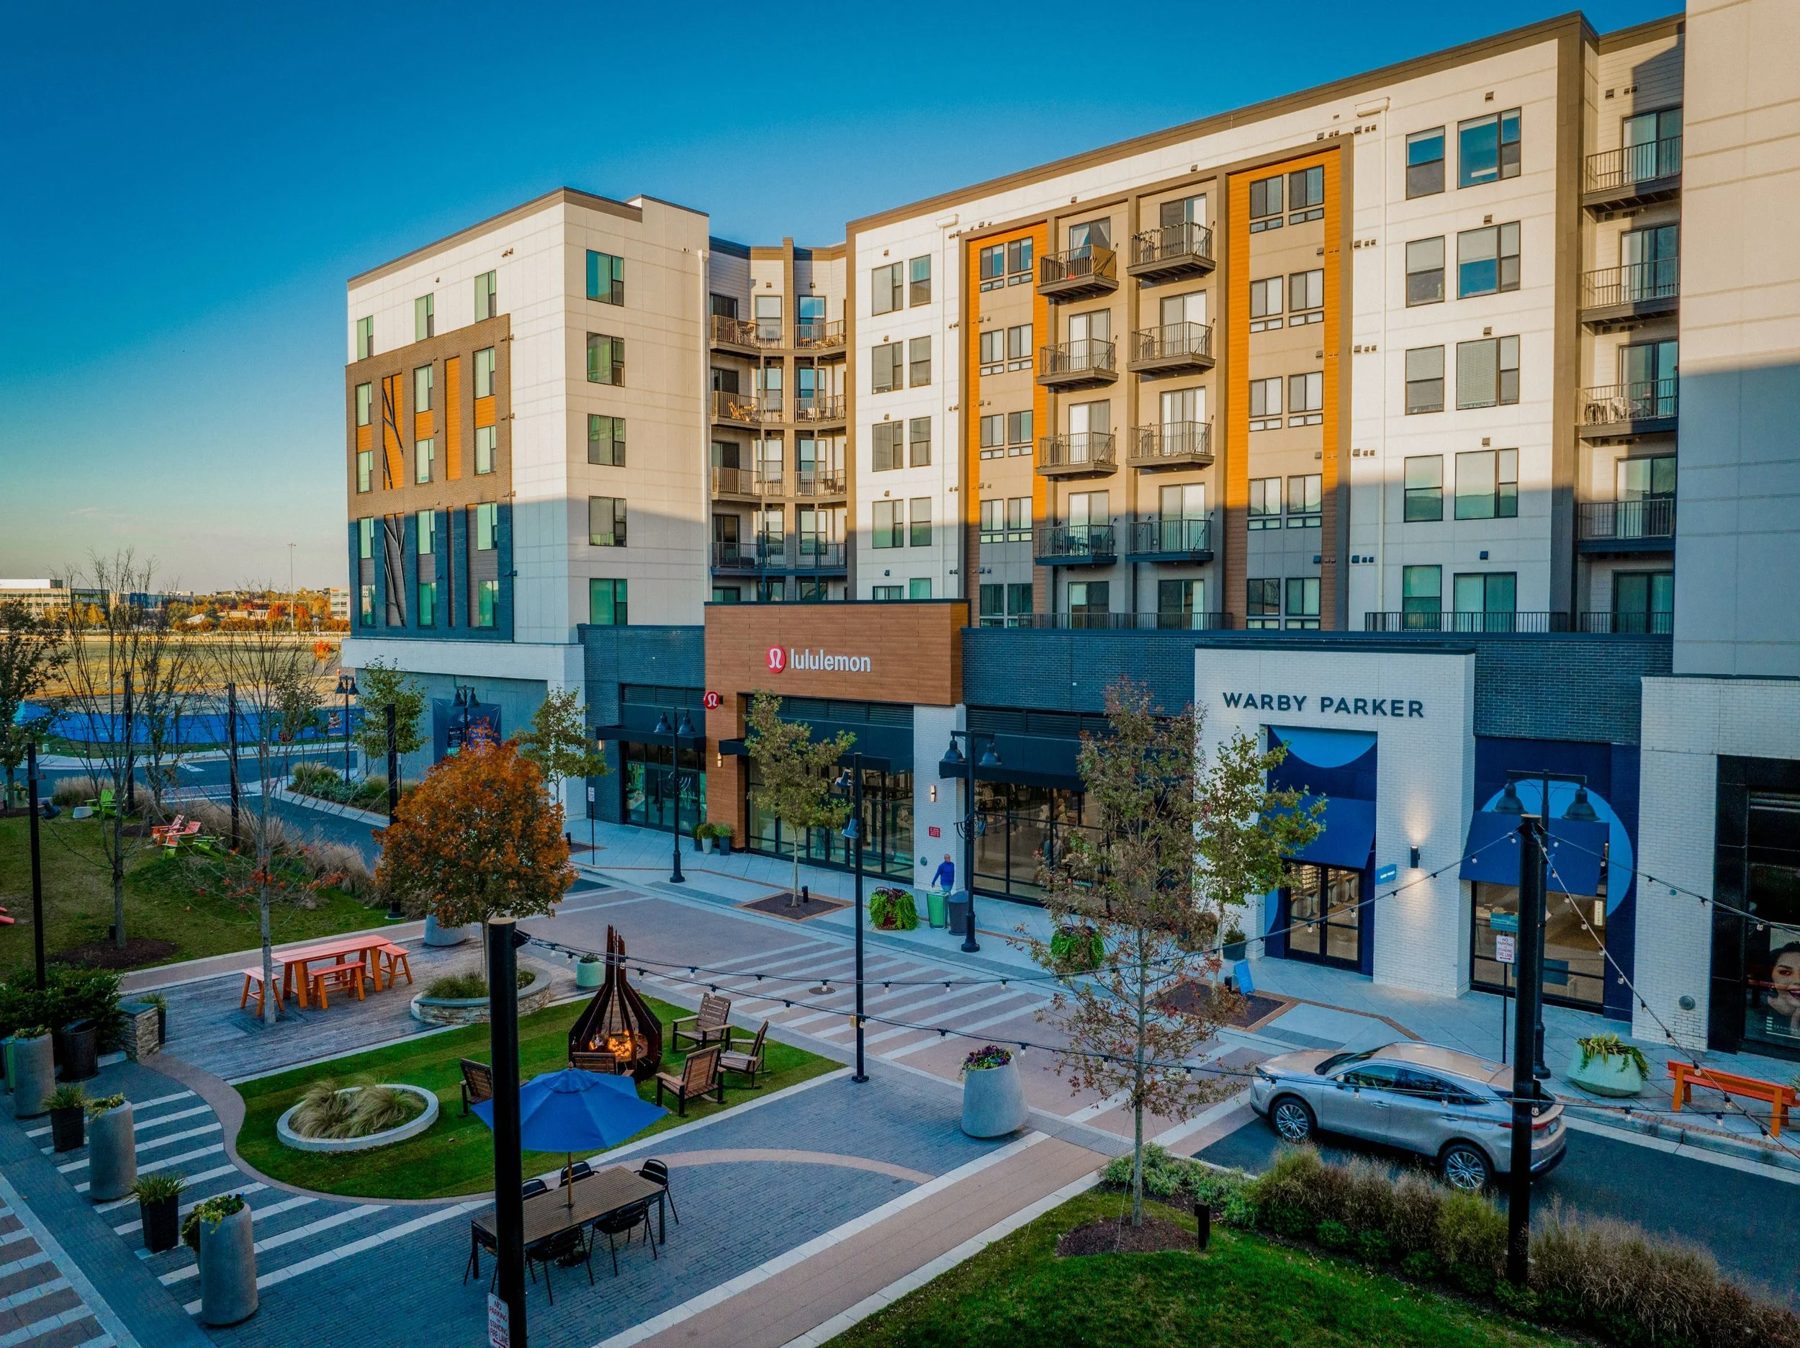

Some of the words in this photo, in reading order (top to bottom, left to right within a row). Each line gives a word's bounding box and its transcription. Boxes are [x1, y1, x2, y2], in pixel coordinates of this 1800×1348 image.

[790, 648, 872, 673] lululemon
[1222, 692, 1307, 712] WARBY
[1320, 696, 1424, 718] PARKER
[489, 1305, 508, 1322] PARKING
[494, 1299, 502, 1310] NO
[489, 1319, 509, 1337] STANDING
